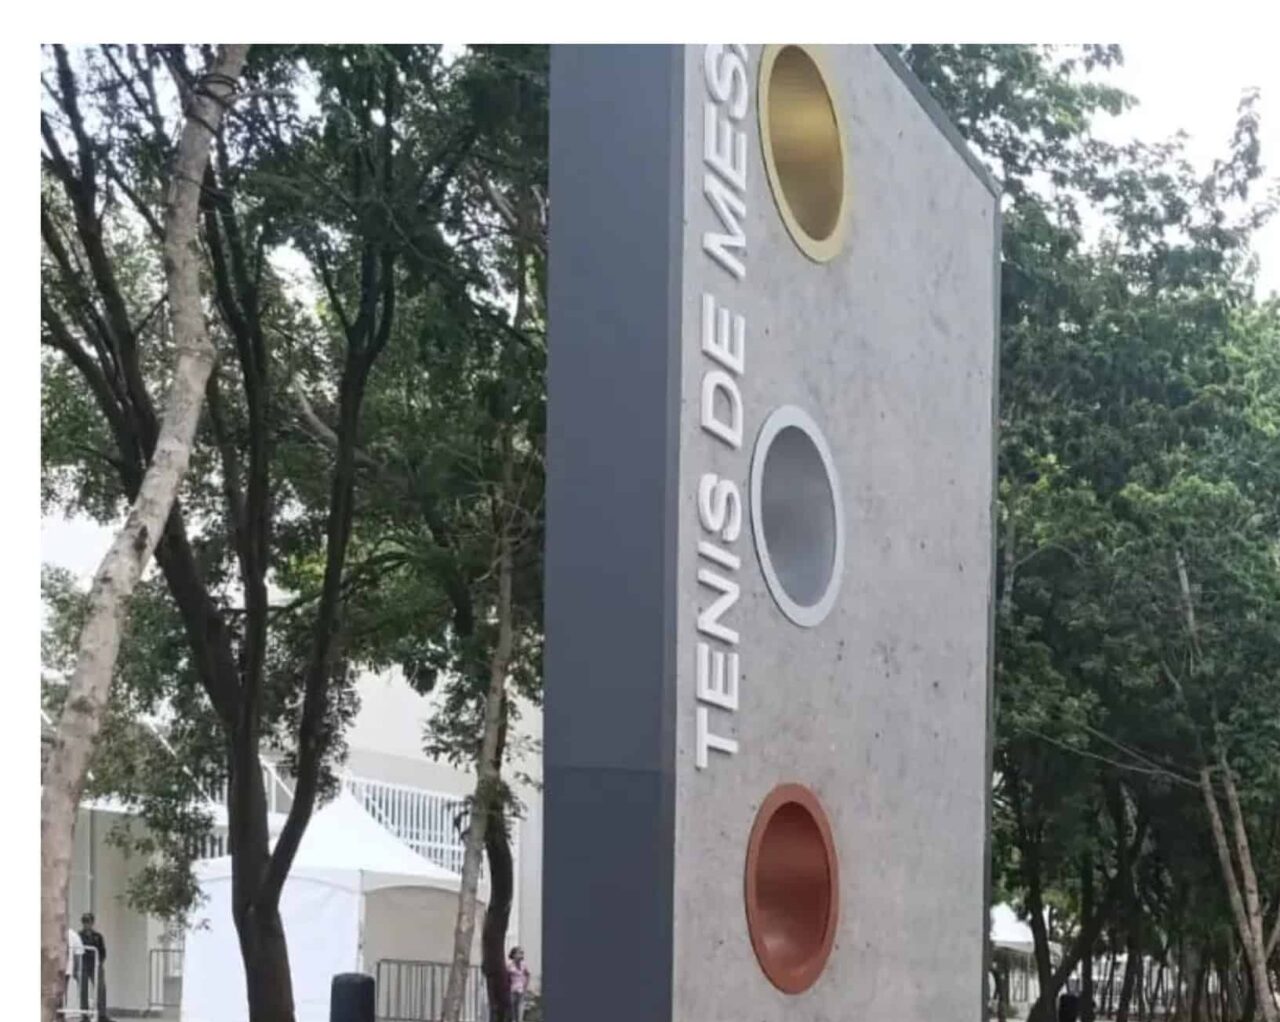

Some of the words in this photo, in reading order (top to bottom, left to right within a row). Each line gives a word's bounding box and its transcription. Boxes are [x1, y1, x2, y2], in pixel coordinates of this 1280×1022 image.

[703, 44, 748, 279] MES
[701, 293, 745, 449] DE
[696, 473, 742, 768] TENIS
